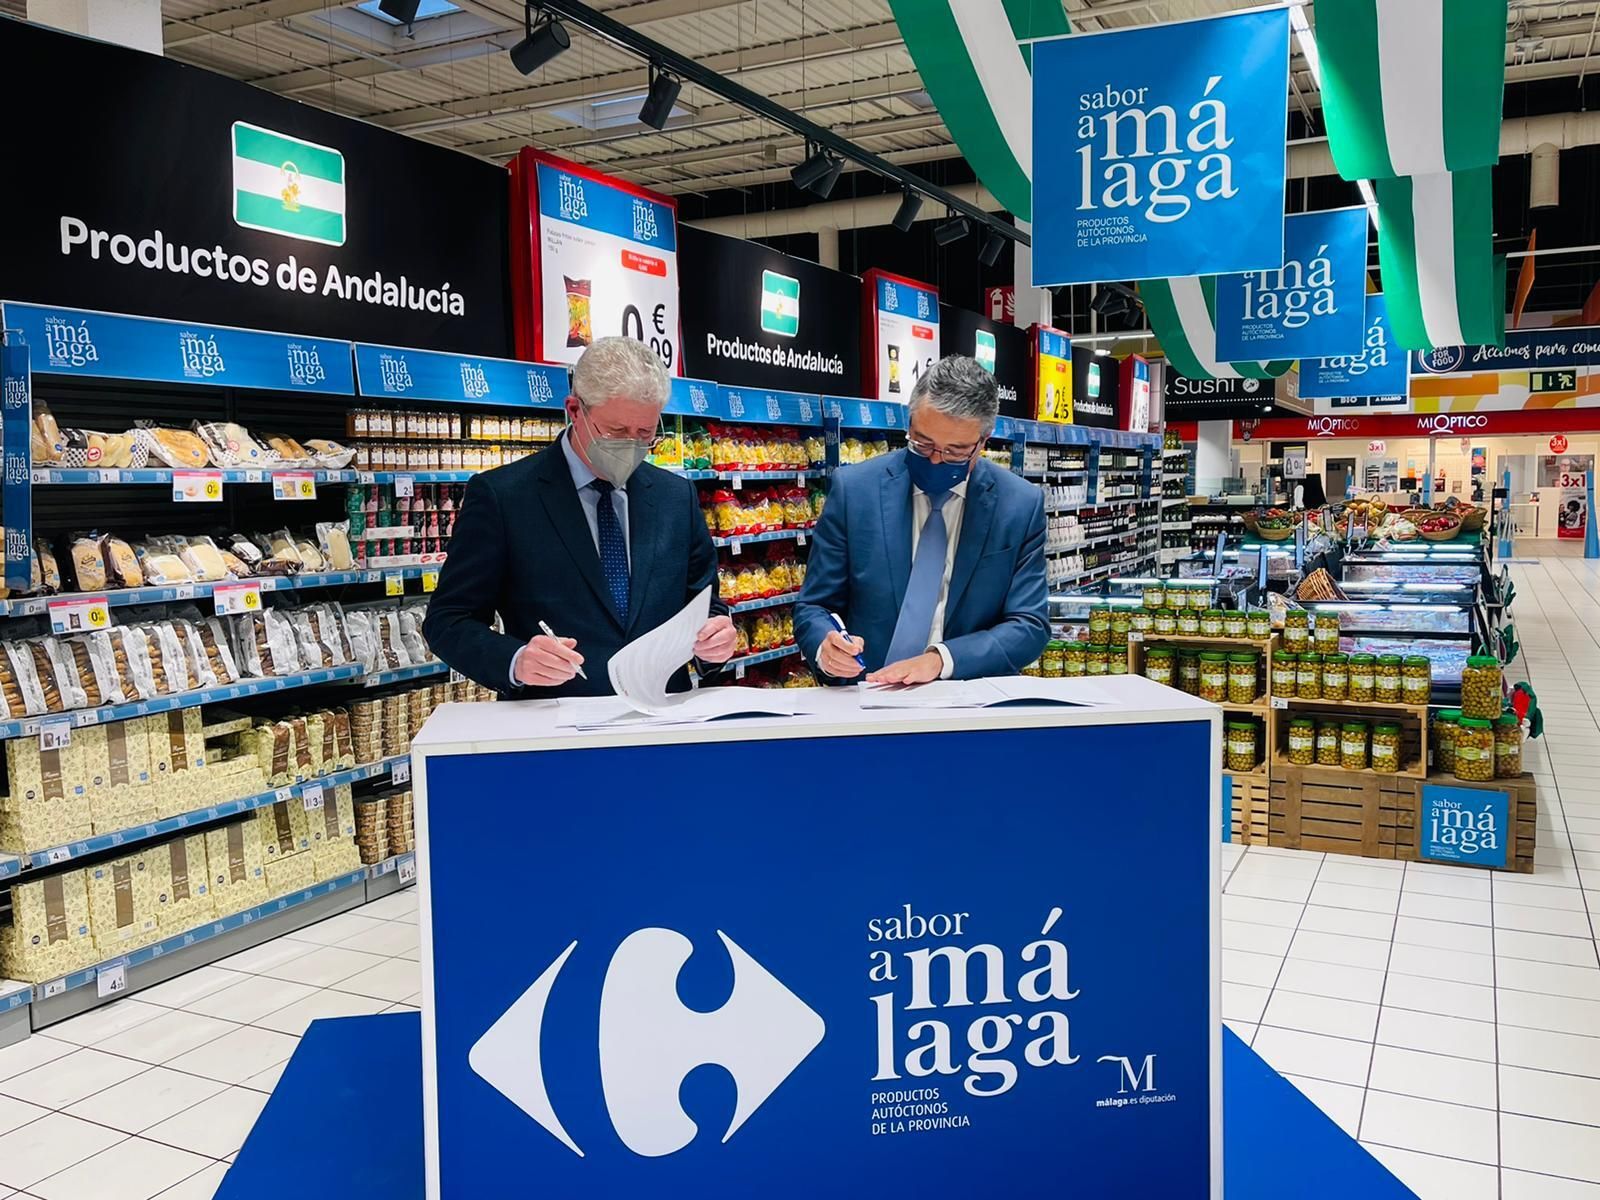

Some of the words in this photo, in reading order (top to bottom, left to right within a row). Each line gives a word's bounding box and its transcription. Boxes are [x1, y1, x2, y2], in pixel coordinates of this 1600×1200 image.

[1079, 84, 1149, 111] sabor
[1075, 144, 1240, 224] laga
[1076, 216, 1130, 229] PRODUCTOS
[1076, 225, 1135, 238] AUTÓCTONOS
[1077, 238, 1089, 248] DE
[1090, 237, 1101, 246] LA
[1102, 234, 1148, 245] PROVINCIA
[60, 215, 270, 287] Productos
[276, 255, 318, 294] de
[321, 264, 466, 317] Andalucía
[1241, 282, 1338, 328] laga
[45, 316, 66, 325] sabor
[652, 303, 665, 335] €
[45, 332, 99, 366] laga
[707, 333, 772, 365] Productos
[772, 344, 786, 367] de
[786, 348, 843, 375] Andalucía
[1433, 350, 1449, 360] FOR
[1535, 343, 1568, 359] para
[180, 346, 225, 376] laga
[1432, 356, 1454, 367] FOOD
[288, 357, 325, 384] laga
[1174, 377, 1235, 395] Sushi
[1369, 442, 1384, 452] 3x1
[1551, 437, 1566, 447] 3x1
[1561, 473, 1586, 488] 3x1
[1432, 799, 1462, 809] sabor
[1430, 818, 1498, 854] laga
[868, 904, 969, 942] sabor
[869, 992, 1081, 1097] laga
[872, 1088, 940, 1104] PRODUCTOS
[1139, 1094, 1176, 1104] diputación
[872, 1102, 948, 1119] AUTÓCTONOS
[872, 1123, 887, 1135] DE
[890, 1121, 905, 1133] LA
[908, 1115, 971, 1131] PROVINCIA
